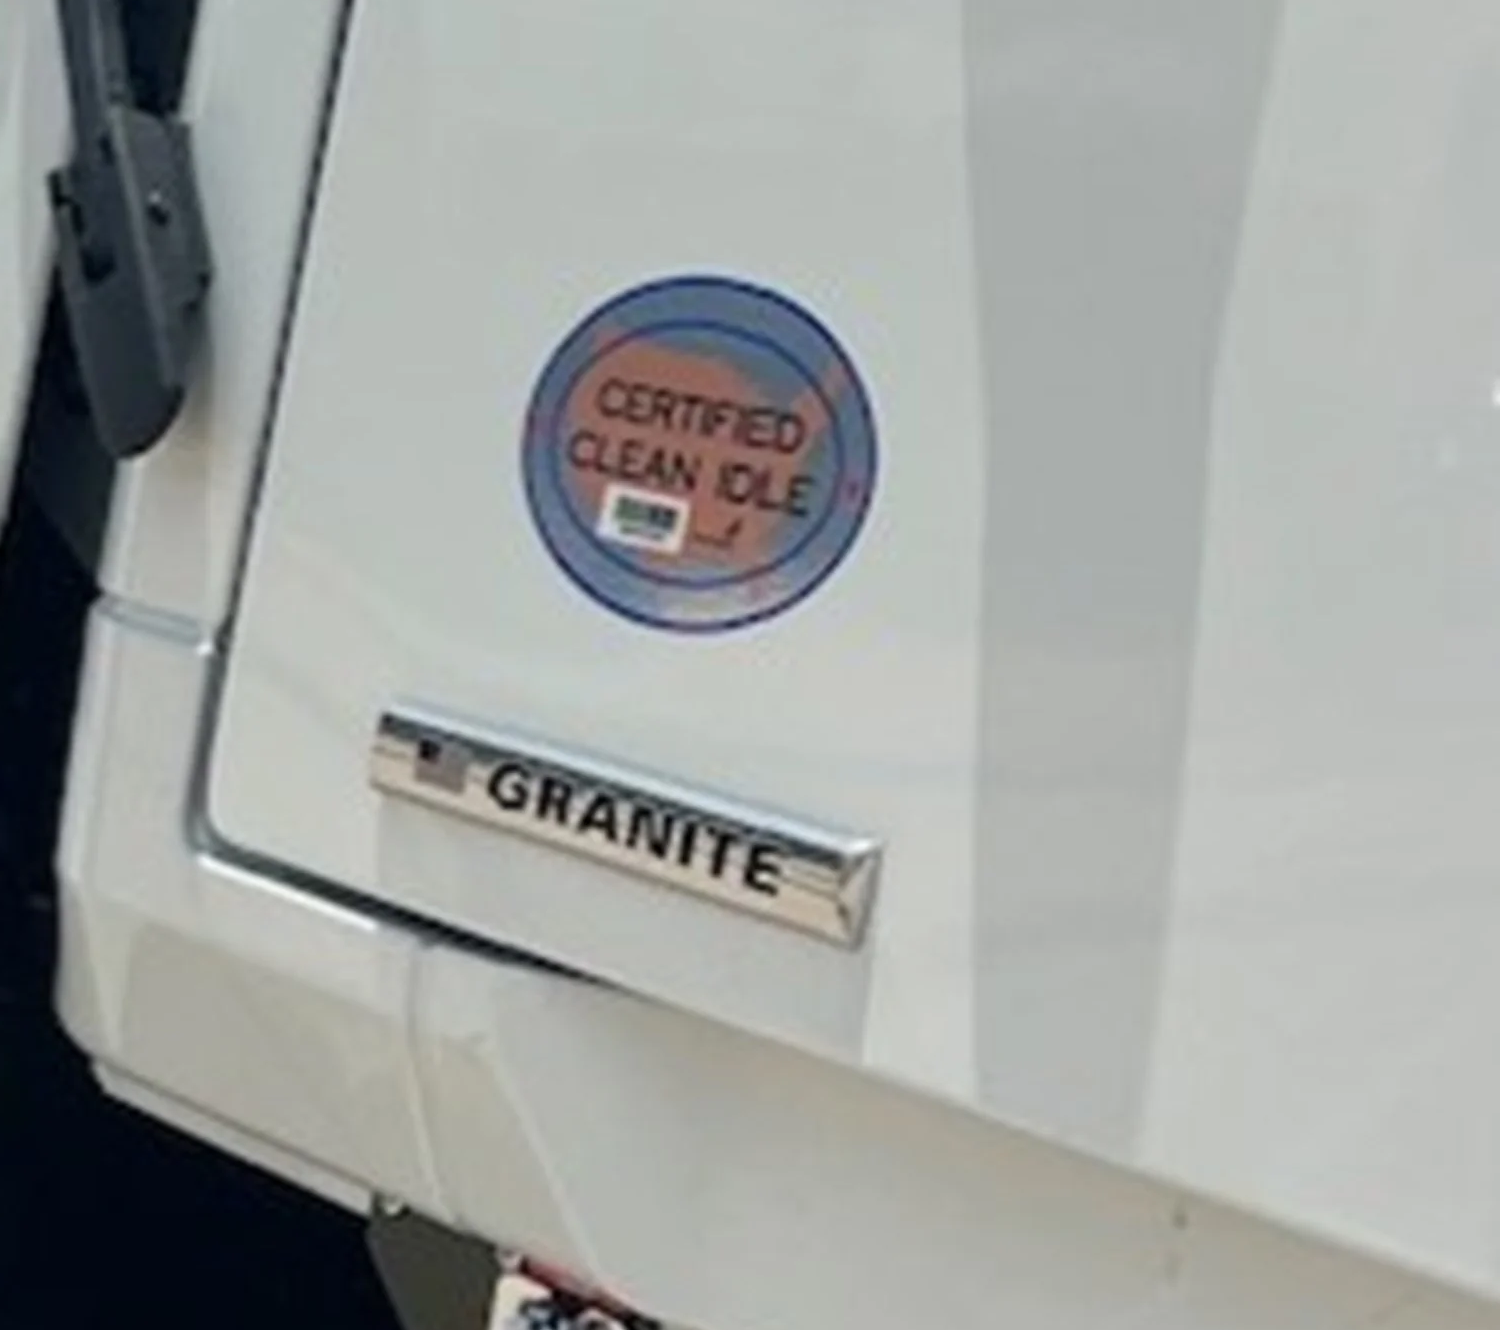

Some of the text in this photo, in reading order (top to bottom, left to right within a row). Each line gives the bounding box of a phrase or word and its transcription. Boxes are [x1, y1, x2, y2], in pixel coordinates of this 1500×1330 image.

[597, 377, 806, 455] CERTIFIED
[569, 430, 700, 493] CLEAN
[716, 461, 815, 519] IDLE
[486, 761, 785, 897] GRANITE
